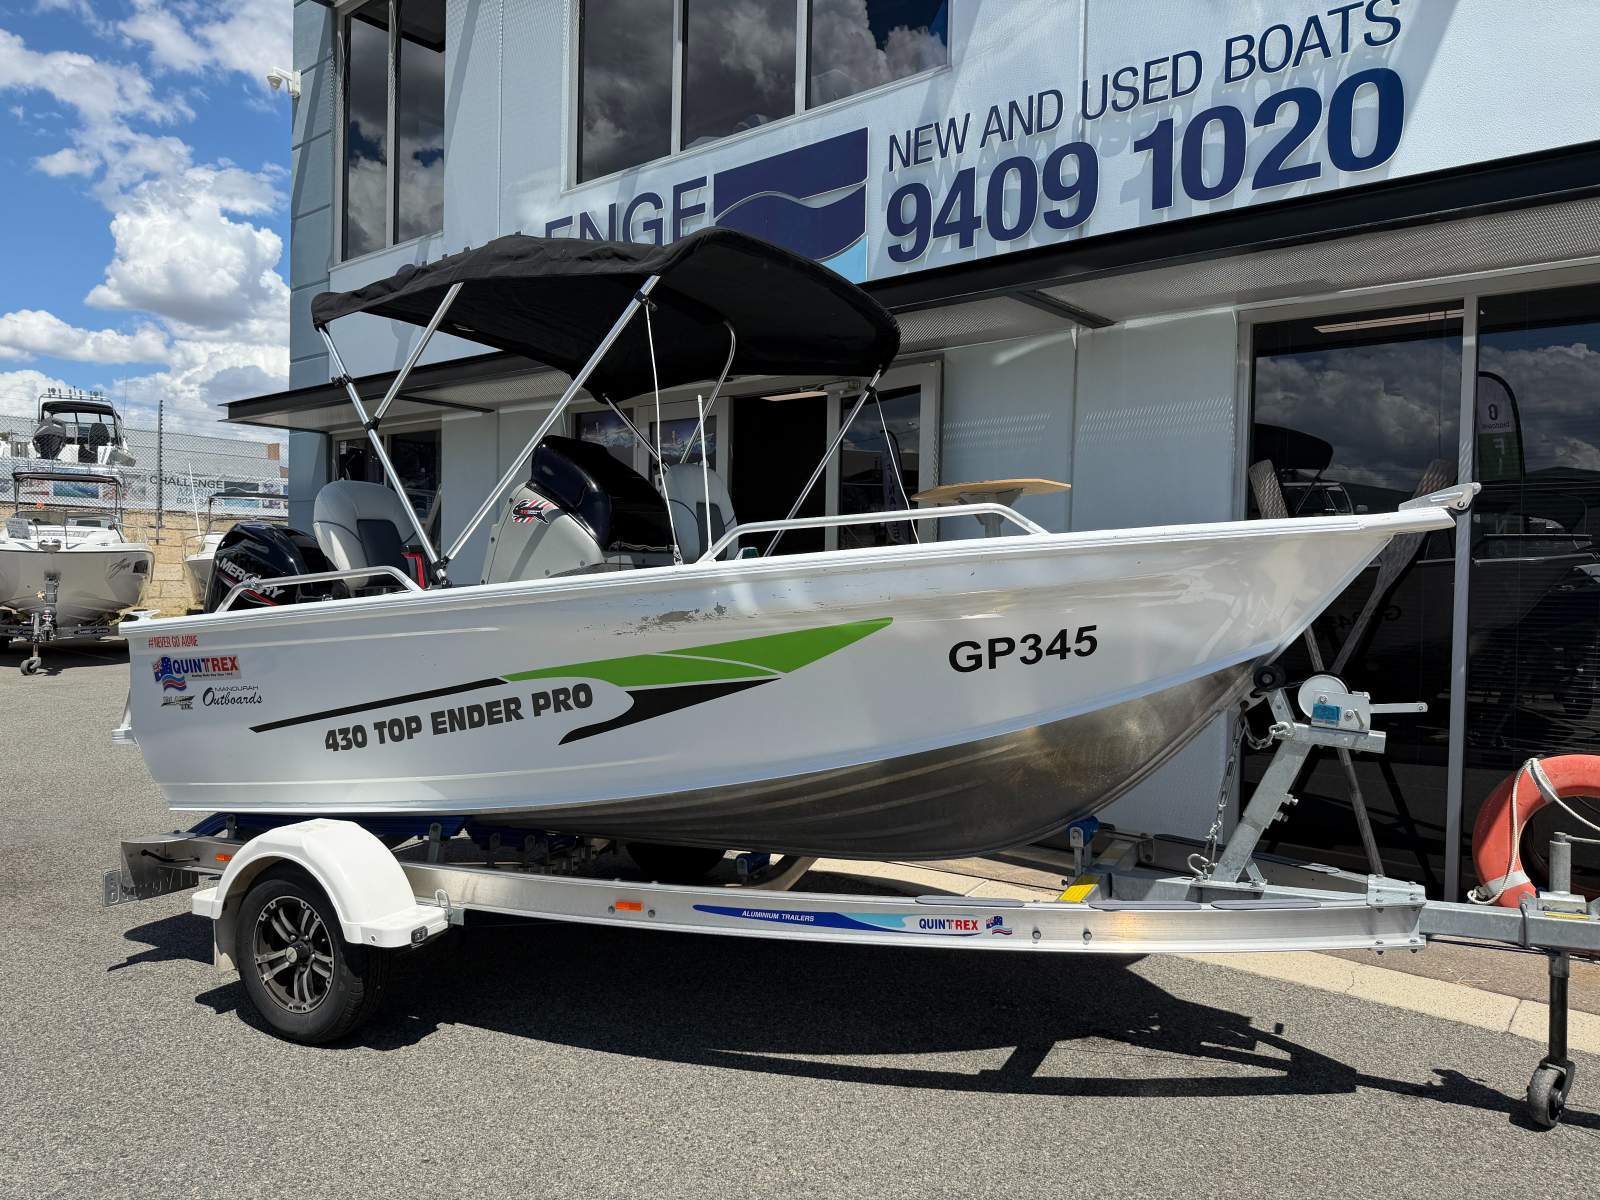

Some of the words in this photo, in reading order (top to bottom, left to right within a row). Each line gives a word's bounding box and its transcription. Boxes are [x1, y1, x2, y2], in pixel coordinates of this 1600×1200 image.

[888, 113, 971, 172] NEW
[979, 89, 1064, 148] AND
[1081, 50, 1203, 121] USED
[1224, 0, 1402, 84] BOATS
[886, 141, 1099, 263] 9409
[1132, 67, 1405, 211] 1020
[149, 475, 224, 489] CHALLENGE
[948, 624, 1099, 673] GP345
[172, 655, 239, 674] QUINTREX
[202, 686, 263, 707] Outboards
[324, 724, 368, 752] 430
[373, 715, 423, 745] TOP
[430, 696, 525, 736] ENDER
[531, 683, 594, 718] PRO
[741, 910, 780, 920] ALUMINIUM
[781, 912, 815, 922] TRAILERS
[918, 917, 979, 931] QUINTREX
